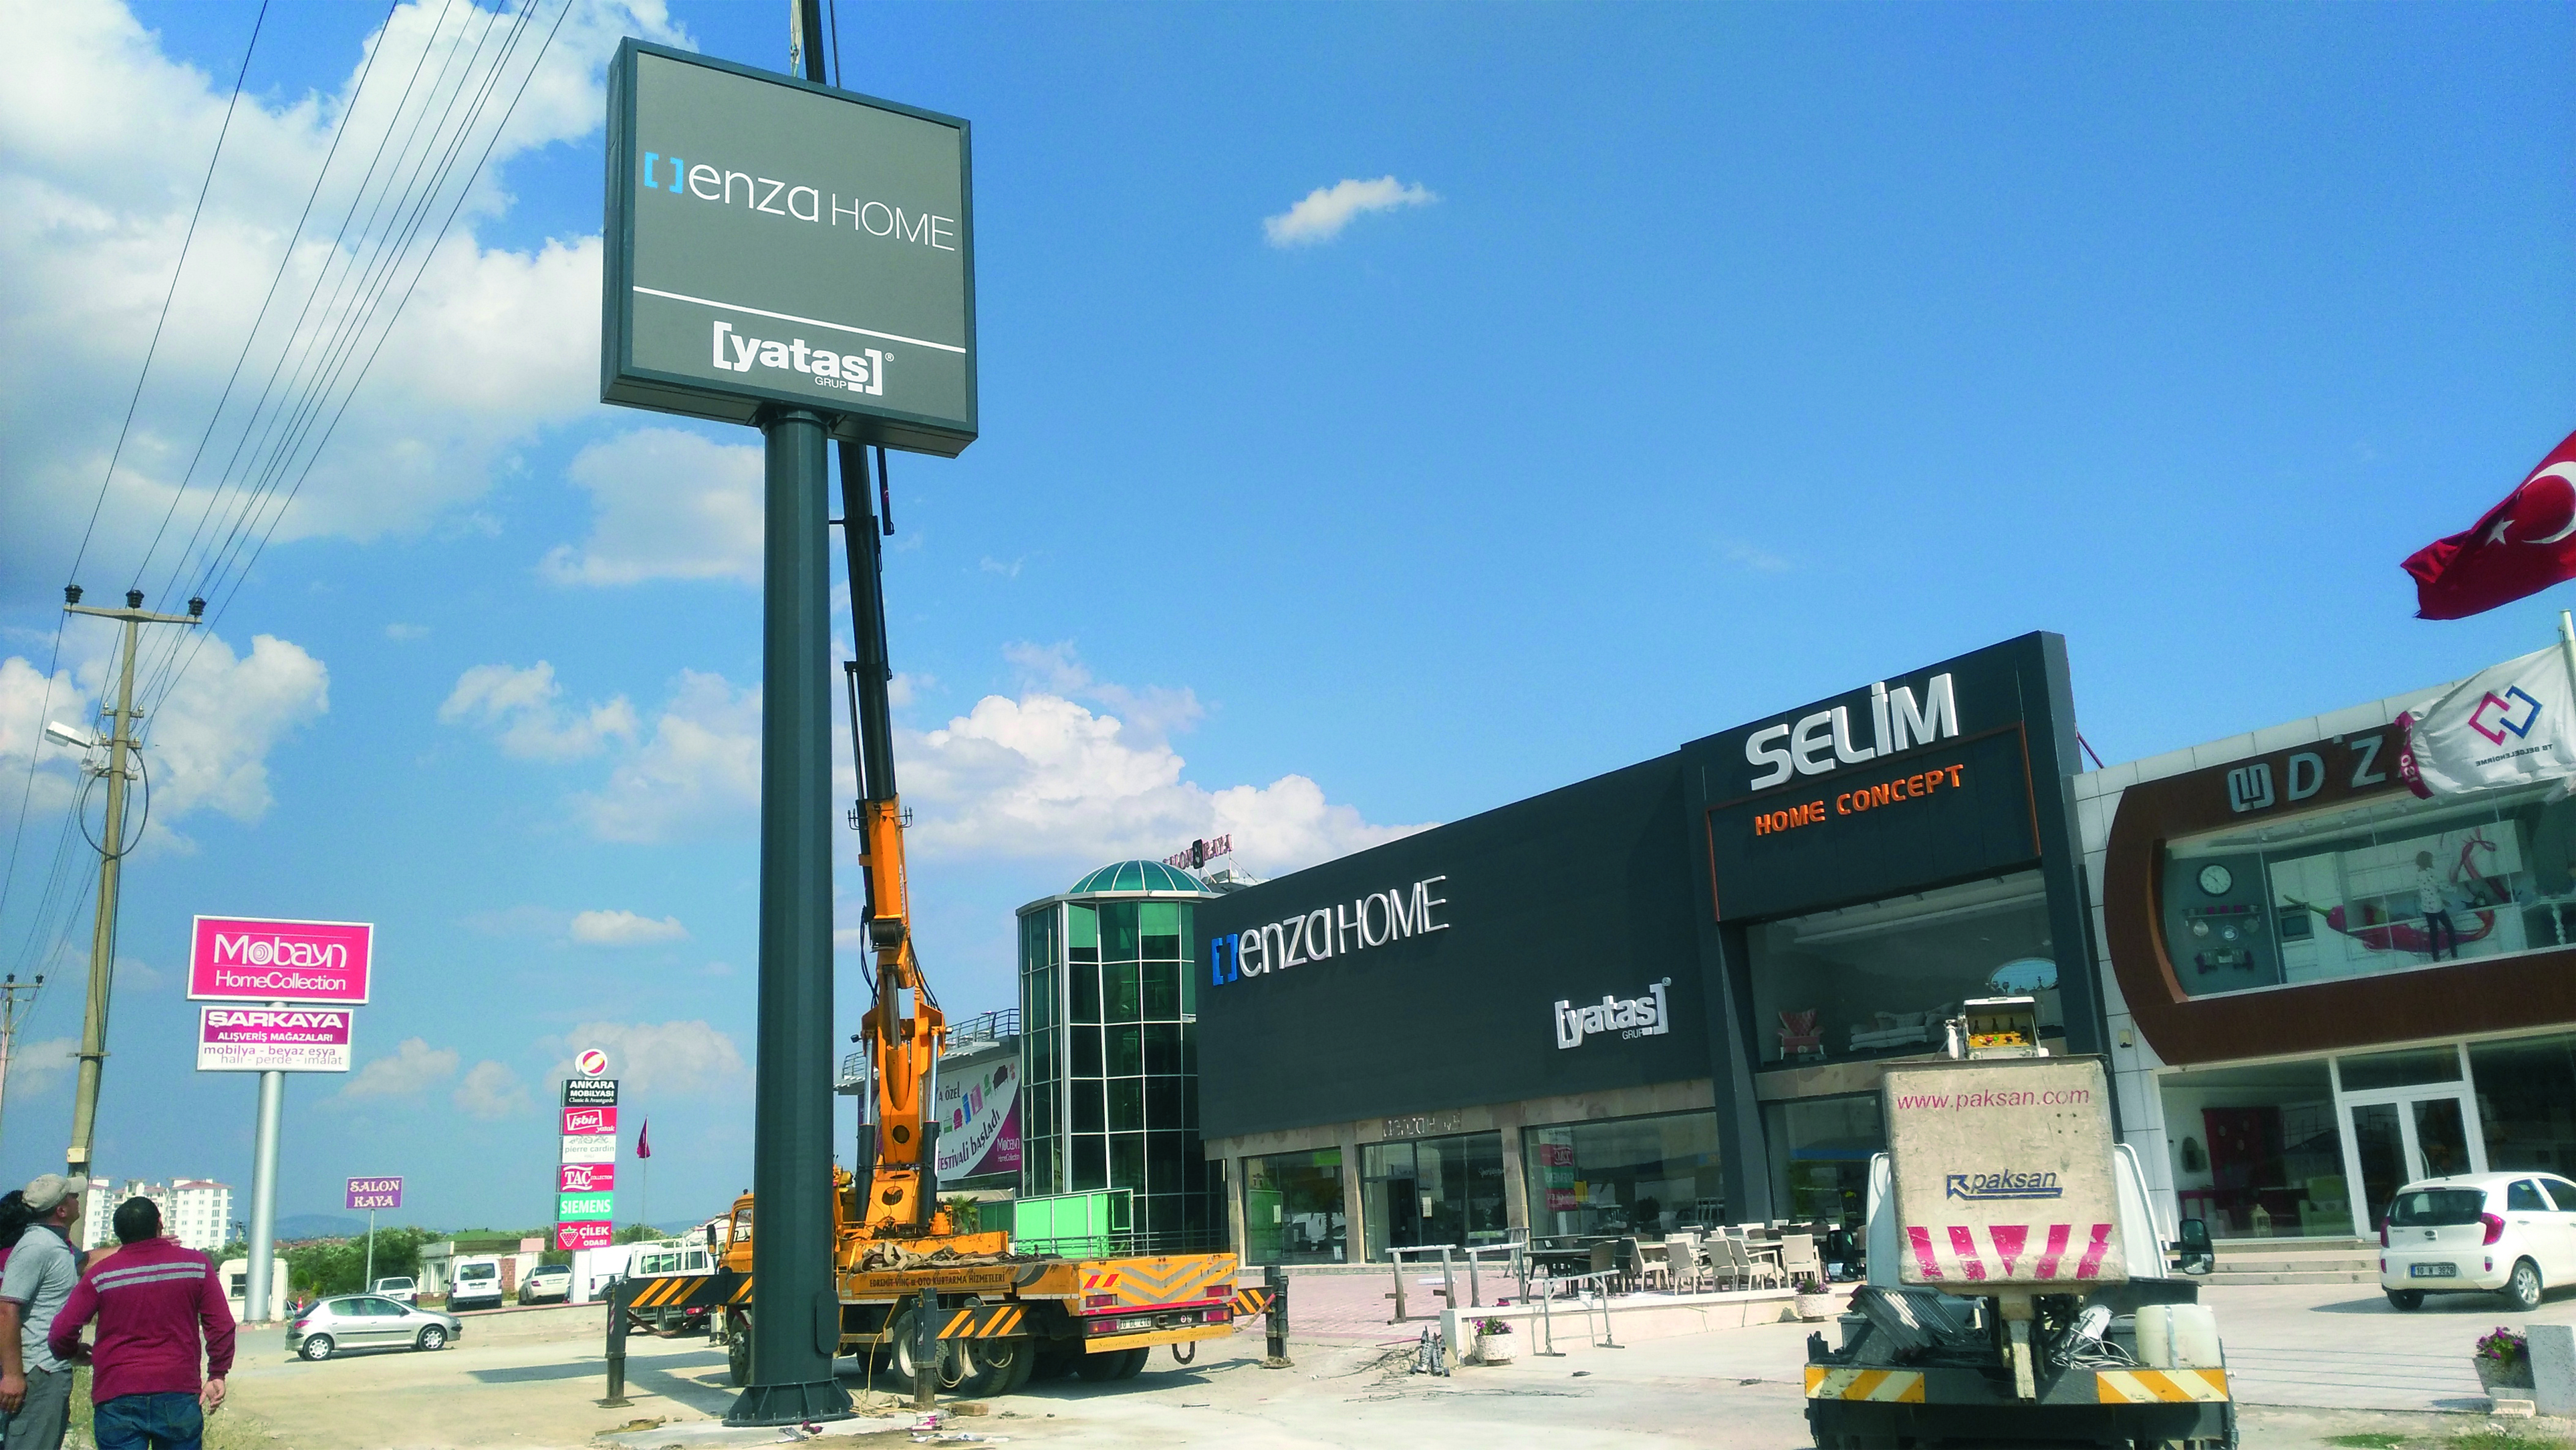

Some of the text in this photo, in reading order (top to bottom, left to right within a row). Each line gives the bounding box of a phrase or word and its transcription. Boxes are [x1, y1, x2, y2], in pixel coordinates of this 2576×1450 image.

[688, 163, 956, 252] enza HOME
[814, 376, 848, 389] GRUP
[1745, 672, 1959, 792] SELİM
[1755, 763, 1964, 836] HOME CONCEPT
[1239, 875, 1450, 978] enza HOME
[213, 933, 348, 968] Mobayn
[215, 969, 346, 991] HomeCollection
[208, 1011, 344, 1028] ŞARKAYA
[217, 1031, 333, 1042] ALIŞVERİŞ MAĞAZALARI
[204, 1046, 255, 1056] mobilya
[269, 1046, 304, 1056] beyaz
[308, 1048, 336, 1057] eşya
[256, 1055, 292, 1066] perde
[569, 1081, 615, 1089] ANKARA
[1898, 1089, 2089, 1112] www.paksan.com
[596, 1125, 615, 1133] yatak
[350, 1181, 400, 1193] SALON
[564, 1171, 592, 1187] TAÇ
[1970, 1169, 2057, 1194] paksan
[354, 1195, 394, 1207] KAYA
[561, 1199, 611, 1214] SIEMENS
[579, 1224, 610, 1239] ÇİLEK
[870, 1277, 894, 1288] EDREMİT
[918, 1277, 932, 1285] OTO
[932, 1275, 967, 1285] KURTARMA
[969, 1271, 1005, 1284] HİZMETLERİ
